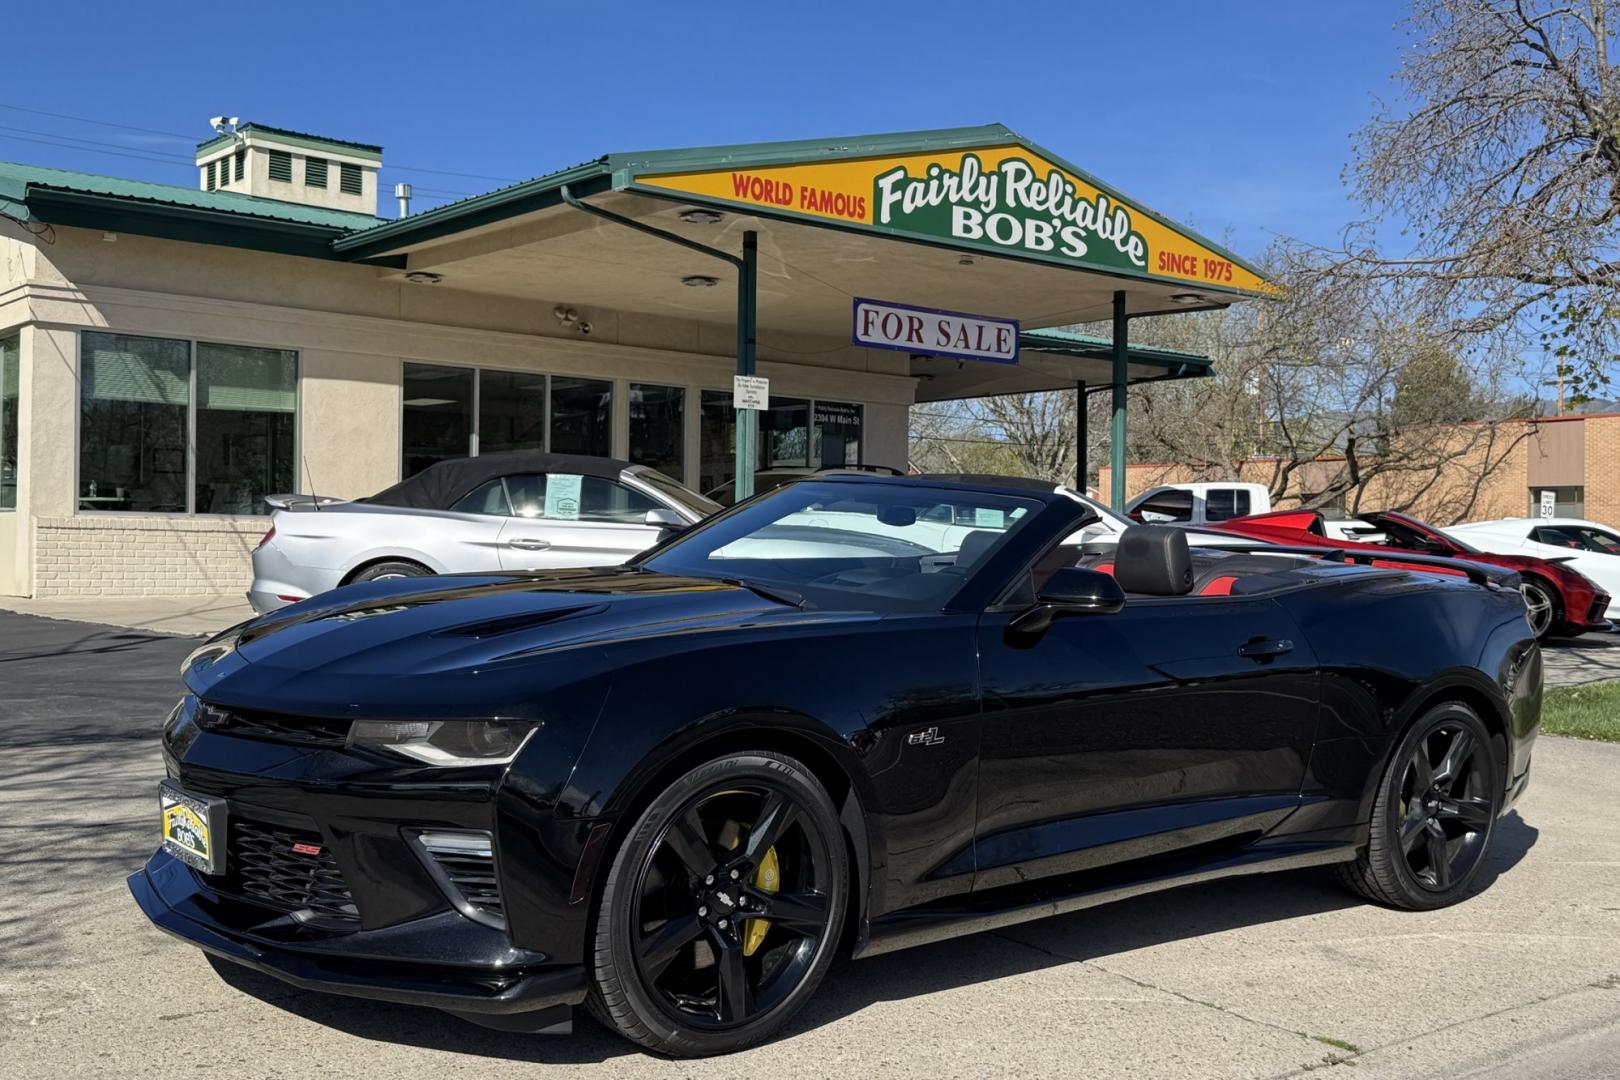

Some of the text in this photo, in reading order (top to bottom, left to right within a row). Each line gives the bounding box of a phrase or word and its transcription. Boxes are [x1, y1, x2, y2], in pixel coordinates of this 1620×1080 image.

[732, 173, 866, 219] WORLD FAMOUS
[878, 157, 1146, 266] Fairly Reliable
[952, 205, 1088, 258] BOB'S
[1158, 251, 1232, 282] SINCE 1975
[861, 308, 1012, 354] FOR SALE
[829, 414, 837, 423] W
[837, 415, 852, 425] Main
[1542, 505, 1553, 516] 30
